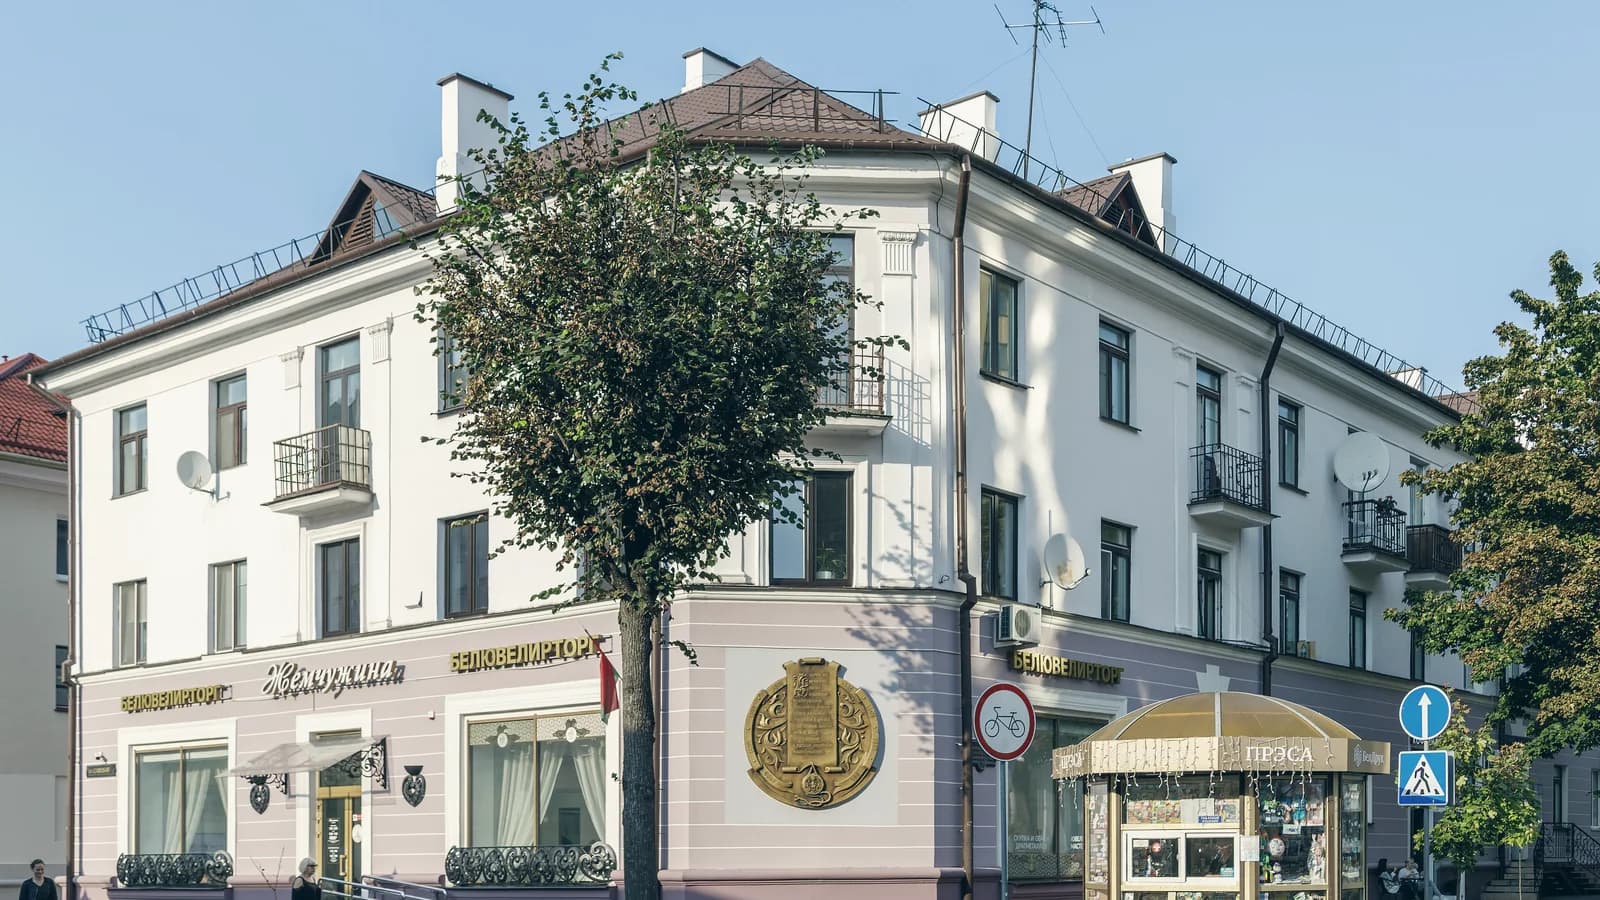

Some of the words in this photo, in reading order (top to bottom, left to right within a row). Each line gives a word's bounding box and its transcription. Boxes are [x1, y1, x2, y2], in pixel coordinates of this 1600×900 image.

[450, 634, 603, 672] БЕЛЮВЕЛИРТОРГ
[1013, 651, 1125, 684] БЕЛЮВЕЛИРТОРГ
[262, 660, 397, 695] Жемчужина
[121, 684, 224, 712] БЕЛЮВЕЛИРТОРГ
[1246, 746, 1315, 762] ПРЭСА
